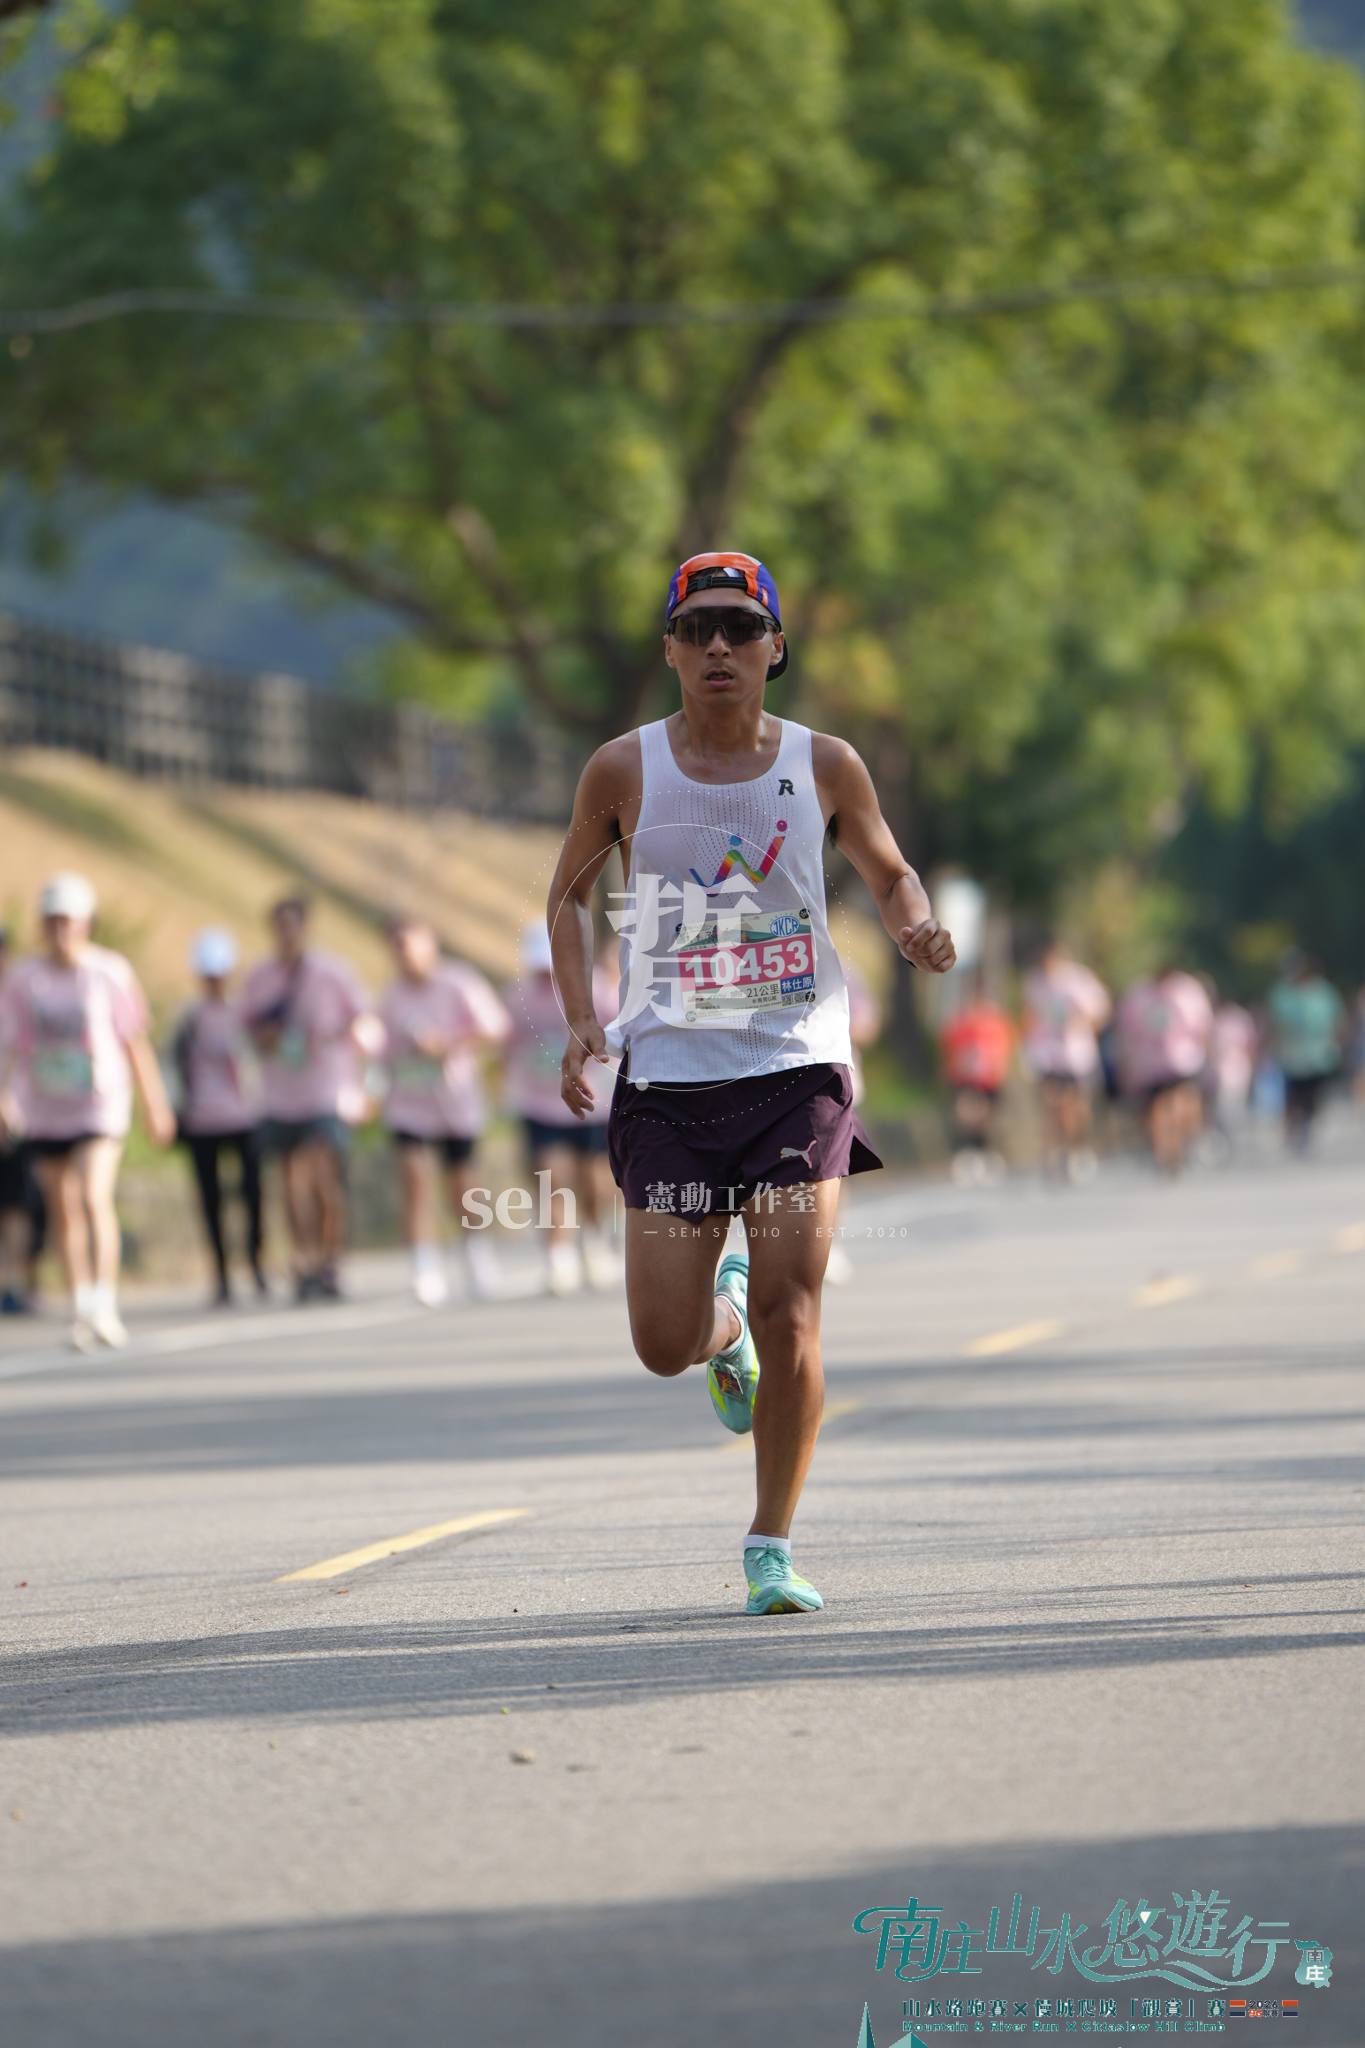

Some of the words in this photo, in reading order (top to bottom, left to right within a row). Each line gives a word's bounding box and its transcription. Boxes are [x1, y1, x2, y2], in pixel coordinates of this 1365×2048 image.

[772, 916, 800, 936] JKCR
[684, 940, 810, 987] 10453
[746, 983, 780, 998] 21公里
